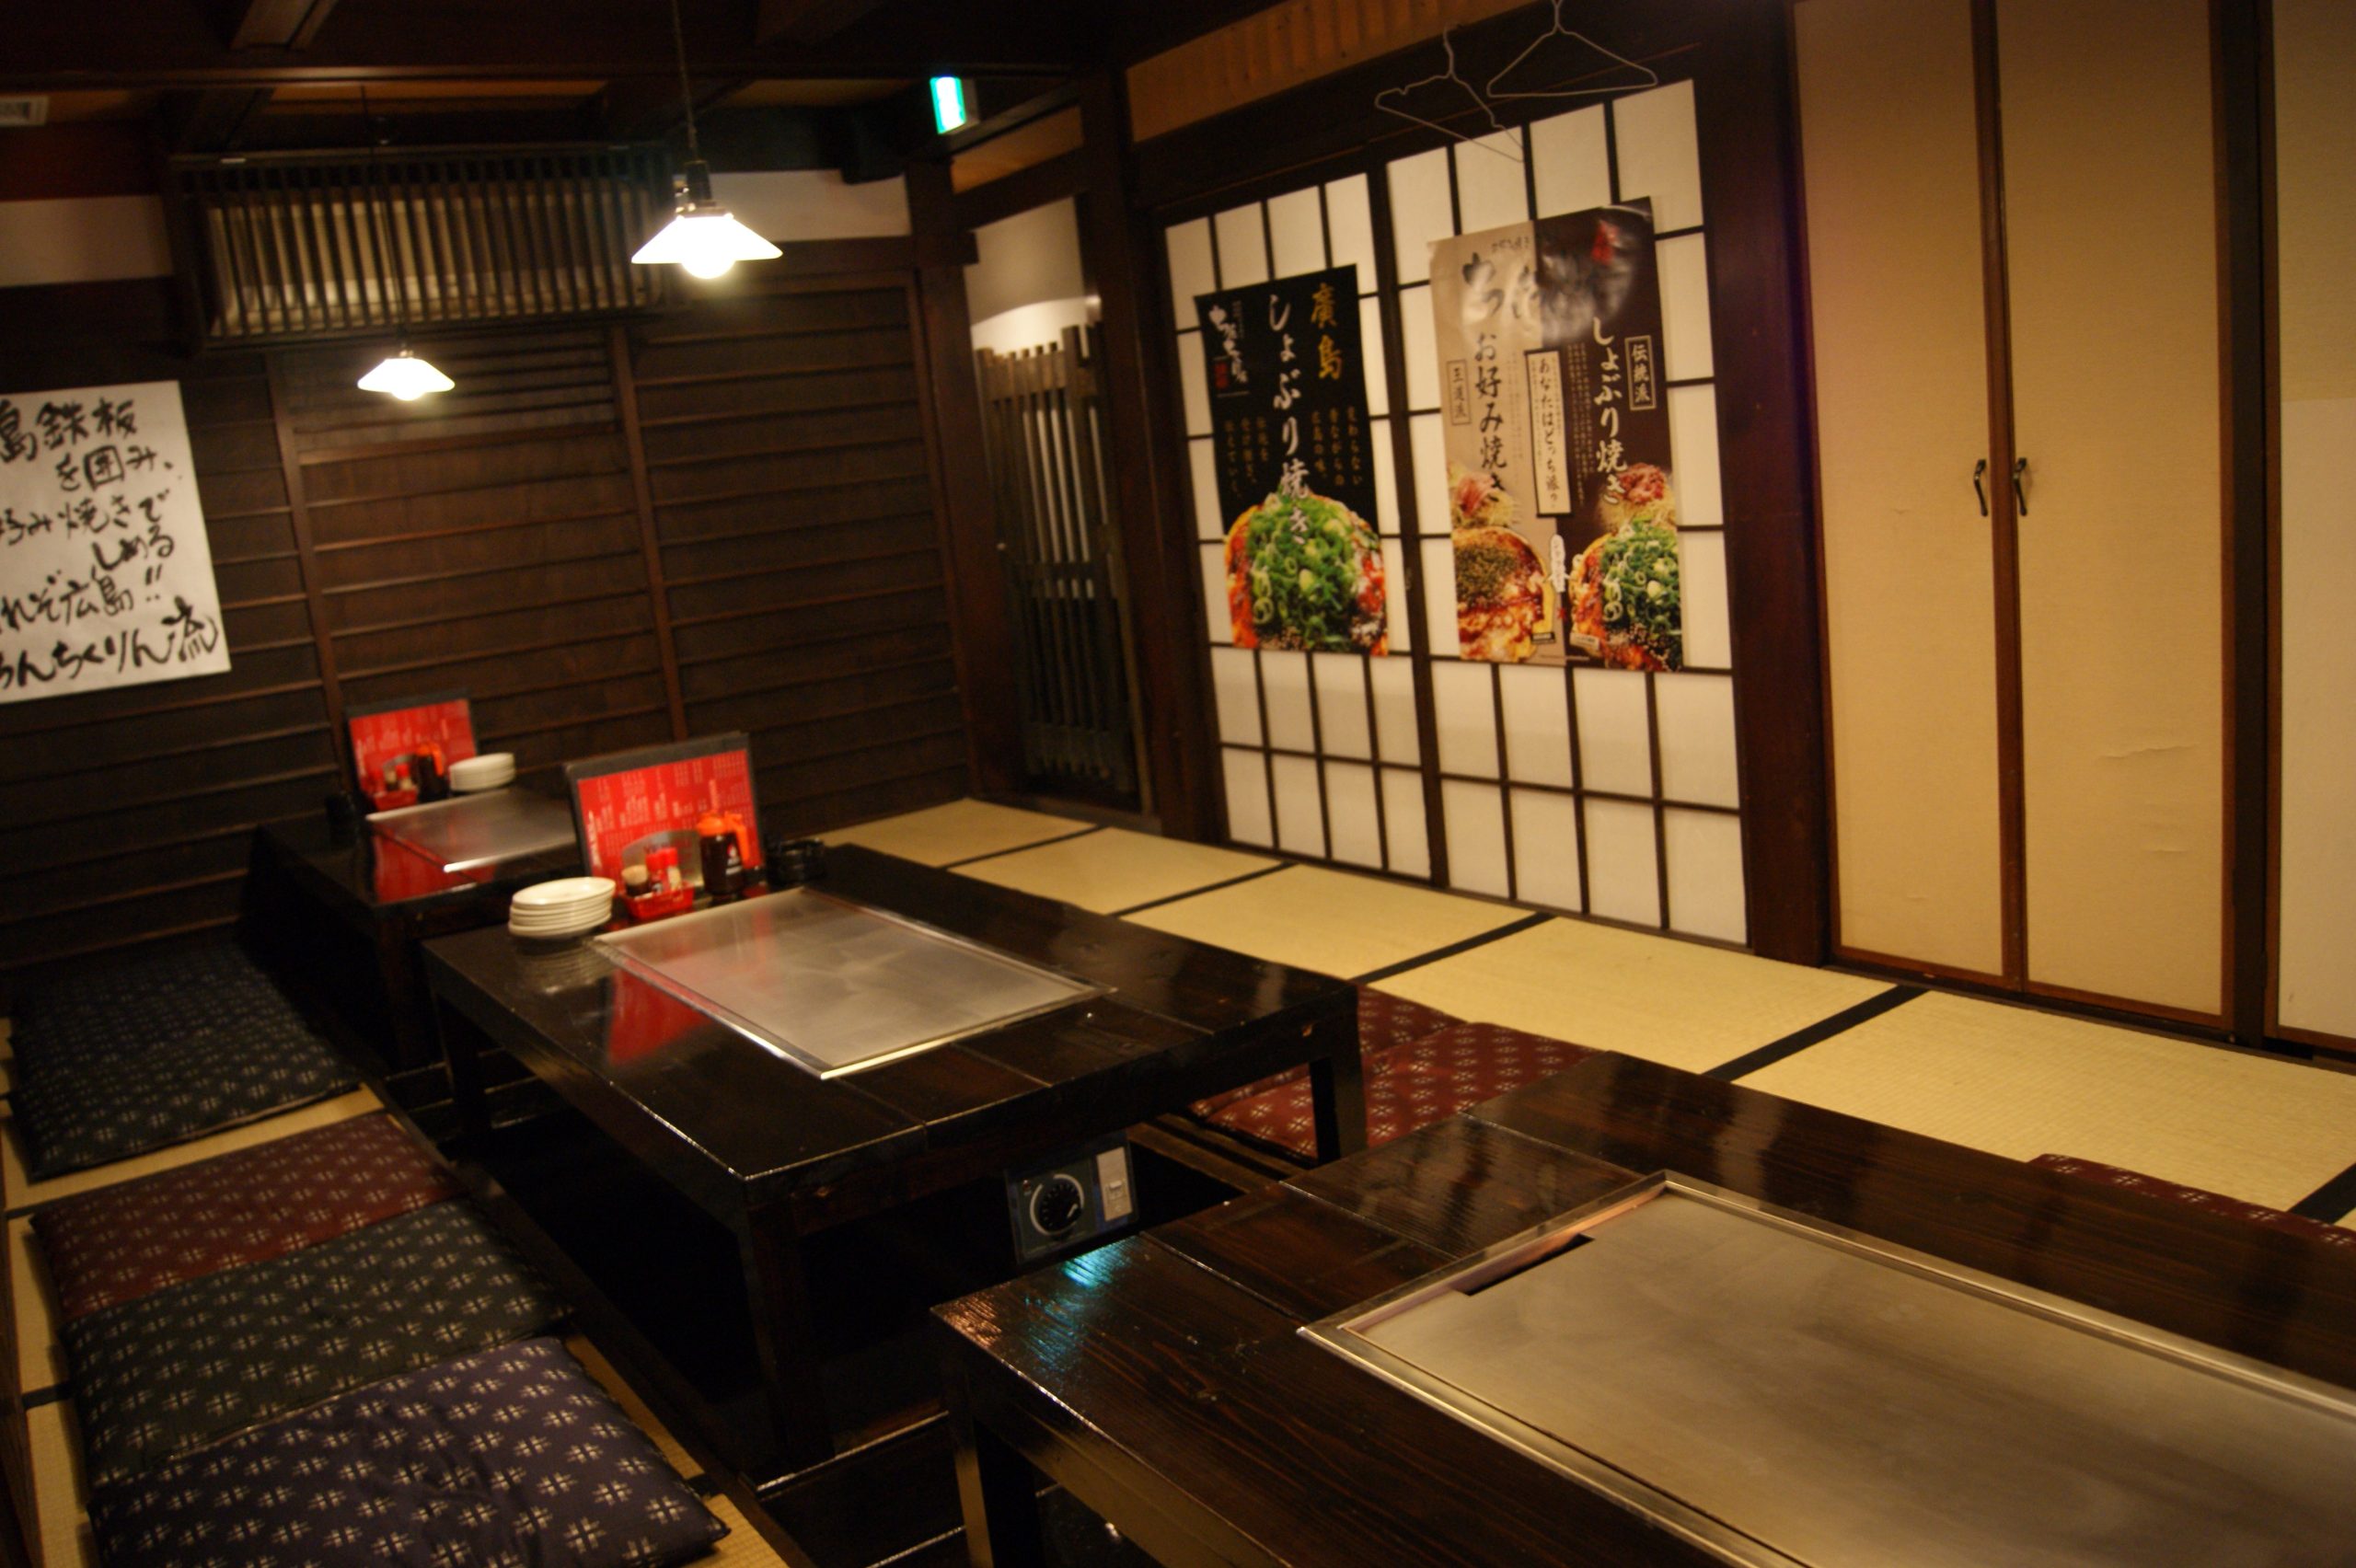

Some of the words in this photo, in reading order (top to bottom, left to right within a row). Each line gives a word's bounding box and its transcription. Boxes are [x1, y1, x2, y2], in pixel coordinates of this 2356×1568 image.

[1268, 294, 1311, 545] しょぶり焼き
[1474, 333, 1508, 502] お好み焼き
[1591, 317, 1627, 505] しょぶり焼き
